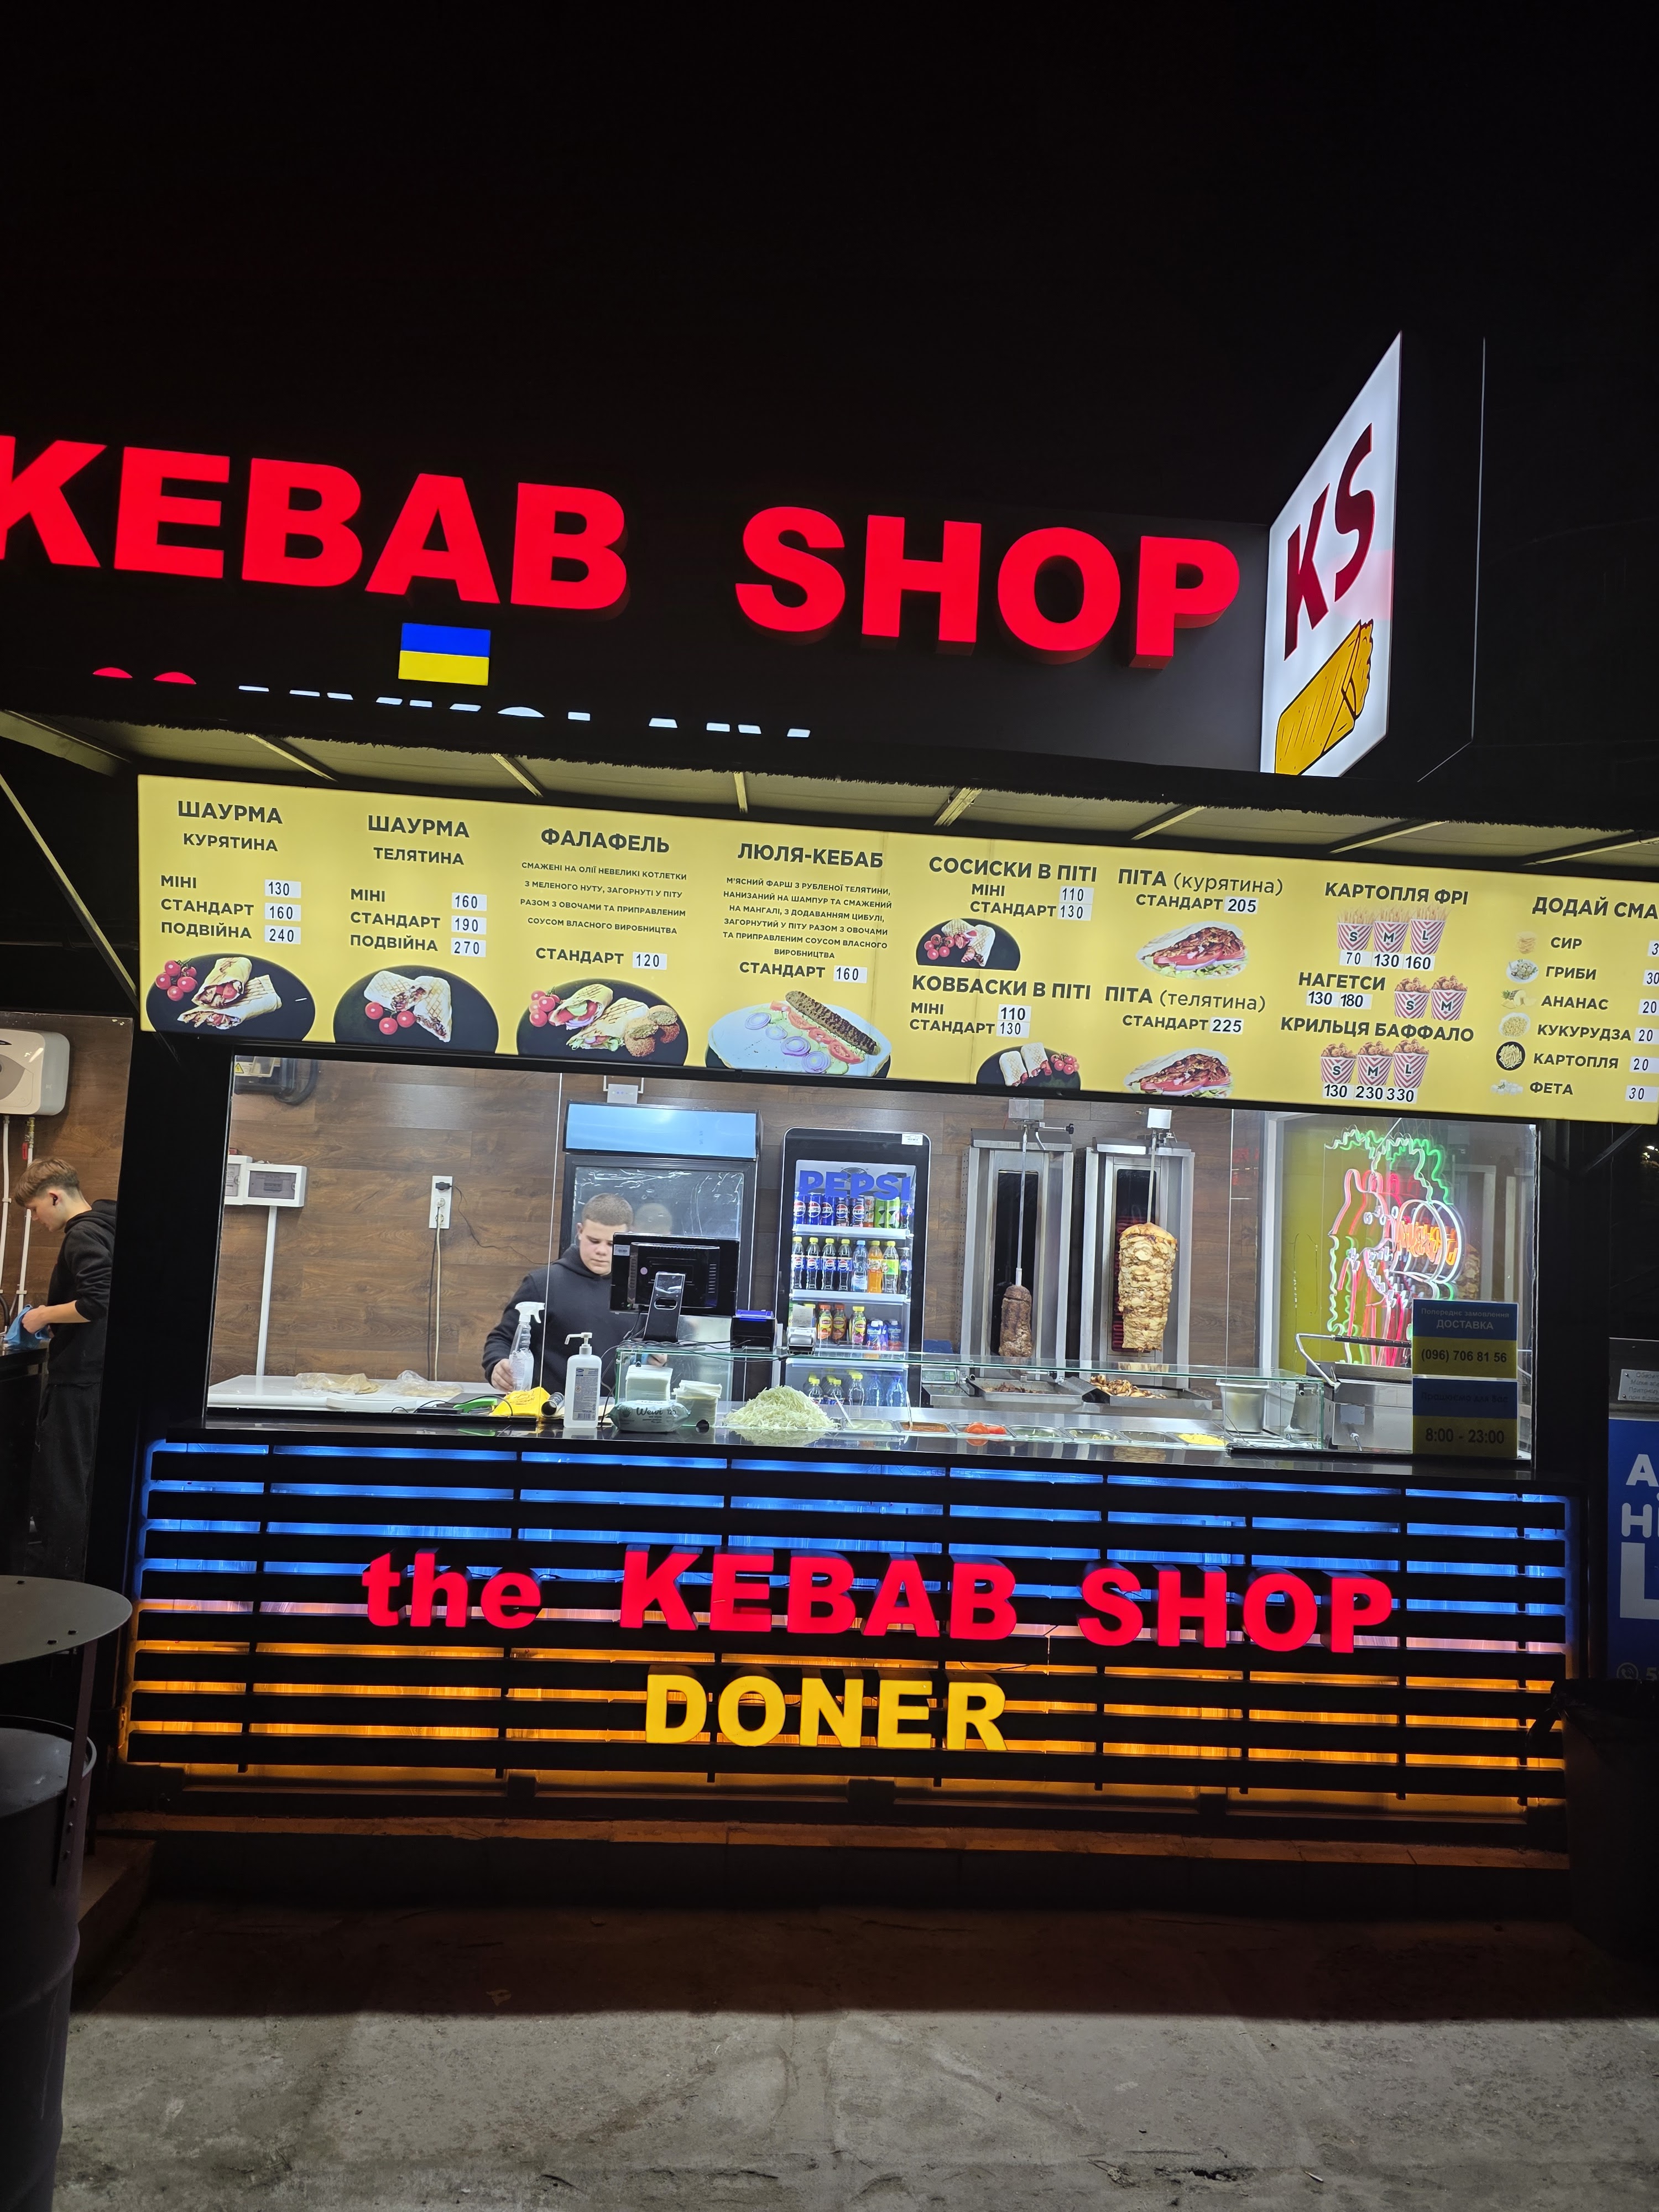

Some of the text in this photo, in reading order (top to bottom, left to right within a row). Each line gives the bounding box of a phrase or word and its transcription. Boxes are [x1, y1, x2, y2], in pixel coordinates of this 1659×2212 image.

[0, 435, 1240, 658] KEBAB SHOP
[1284, 422, 1375, 661] KS
[178, 800, 283, 825] ШАУРМА
[368, 815, 470, 838] ШАУРМА
[184, 833, 278, 852] КУРЯТИНА
[541, 828, 670, 853] ФАЛАФЕЛЬ
[373, 847, 465, 865] ТЕЛЯТИНА
[737, 843, 883, 868] ЛЮЛЯ-КЕБАБ
[521, 862, 562, 871] СМАЖЕНІ
[578, 865, 597, 874] ОЛІЇ
[598, 867, 640, 877] НЕВЕЛИКІ
[642, 870, 687, 880] КОТЛЕТКИ
[929, 856, 1097, 882] СОСИСКИ В ПІТІ
[161, 874, 290, 896] МІНІ 130
[532, 881, 578, 890] МЕЛЕНОГО
[580, 884, 605, 894] НУТУ,
[607, 886, 654, 896] ЗАГОРНУТІ
[727, 877, 764, 886] М'ЯСНИЙ
[766, 880, 793, 888] ФАРШ
[801, 883, 844, 892] РУБЛЕНОЇ
[844, 885, 890, 896] ТЕЛЯТИНИ,
[1118, 868, 1283, 896] ПІТА (курятина)
[351, 888, 478, 909] МІНІ 160
[723, 890, 775, 900] НАНИЗАНИЙ
[791, 895, 828, 904] ШАМПУР
[843, 899, 892, 909] СМАЖЕНИЙ
[971, 883, 1084, 901] МІНІ 110
[1324, 881, 1468, 905] КАРТОПЛЯ ФРІ
[161, 898, 293, 920] СТАНДАРТ 160
[520, 898, 550, 907] РАЗОМ
[559, 901, 602, 911] ОВОЧАМИ
[617, 905, 686, 917] ПРИПРАВЛЕНИМ
[970, 900, 1083, 919] СТАНДАРТ 130
[1136, 894, 1256, 912] СТАНДАРТ 205
[1531, 896, 1658, 920] ДОДАЙ СМА
[350, 911, 478, 932] СТАНДАРТ 190
[743, 905, 782, 916] МАНГАЛІ,
[791, 909, 850, 920] ДОДАВАННЯМ
[852, 913, 884, 923] ЦИБУЛІ,
[161, 921, 294, 942] ПОДВІЙНА 240
[528, 917, 677, 935] СОУСОМ ВЛАСНОГО ВИРОБНИЦТВА
[724, 918, 779, 928] ЗАГОРНУТИЙ
[809, 924, 838, 932] РАЗОМ
[846, 927, 888, 936] ОВОЧАМИ
[350, 934, 479, 954] ПОДВІЙНА 270
[736, 932, 803, 943] ПРИПРАВЛЕНИМ
[805, 937, 841, 946] СОУСОМ
[842, 940, 888, 949] ВЛАСНОГО
[1349, 930, 1430, 943] S M L
[774, 948, 835, 959] ВИРОБНИЦТВА
[1551, 937, 1659, 956] СИР 3
[535, 947, 659, 968] СТАНДАРТ 120
[1347, 952, 1431, 970] 70 130 160
[739, 962, 859, 981] СТАНДАРТ 160
[1546, 966, 1659, 985] ГРИБИ 30
[912, 974, 1091, 1000] КОВБАСКИ В ПІТІ
[1298, 972, 1386, 991] НАГЕТСИ
[1105, 986, 1266, 1013] ПІТА (телятина)
[1308, 991, 1364, 1008] 130 180
[1405, 1000, 1453, 1012] S M
[1541, 995, 1657, 1014] АНАНАС 20
[911, 1002, 1026, 1021] МІНІ 110
[909, 1019, 1021, 1035] СТАНДАРТ 130
[1122, 1015, 1242, 1033] СТАНДАРТ 225
[1281, 1016, 1474, 1042] КРИЛЬЦЯ БАФФАЛО
[1537, 1024, 1653, 1042] КУКУРУДЗА 20
[1332, 1063, 1412, 1077] S M L
[1533, 1053, 1649, 1071] КАРТОПЛЯ 20
[1324, 1084, 1414, 1103] 130 230 330
[1530, 1081, 1645, 1100] ФЕТА 30
[799, 1170, 911, 1201] PEPSI
[1437, 1319, 1493, 1329] ДОСТАВКА
[1421, 1349, 1507, 1363] (096) 706 81 56
[1425, 1428, 1453, 1442] 8:00
[1468, 1430, 1504, 1444] 23:00
[362, 1551, 1392, 1654] the KEBAB SHOP
[645, 1674, 1008, 1751] DONER
